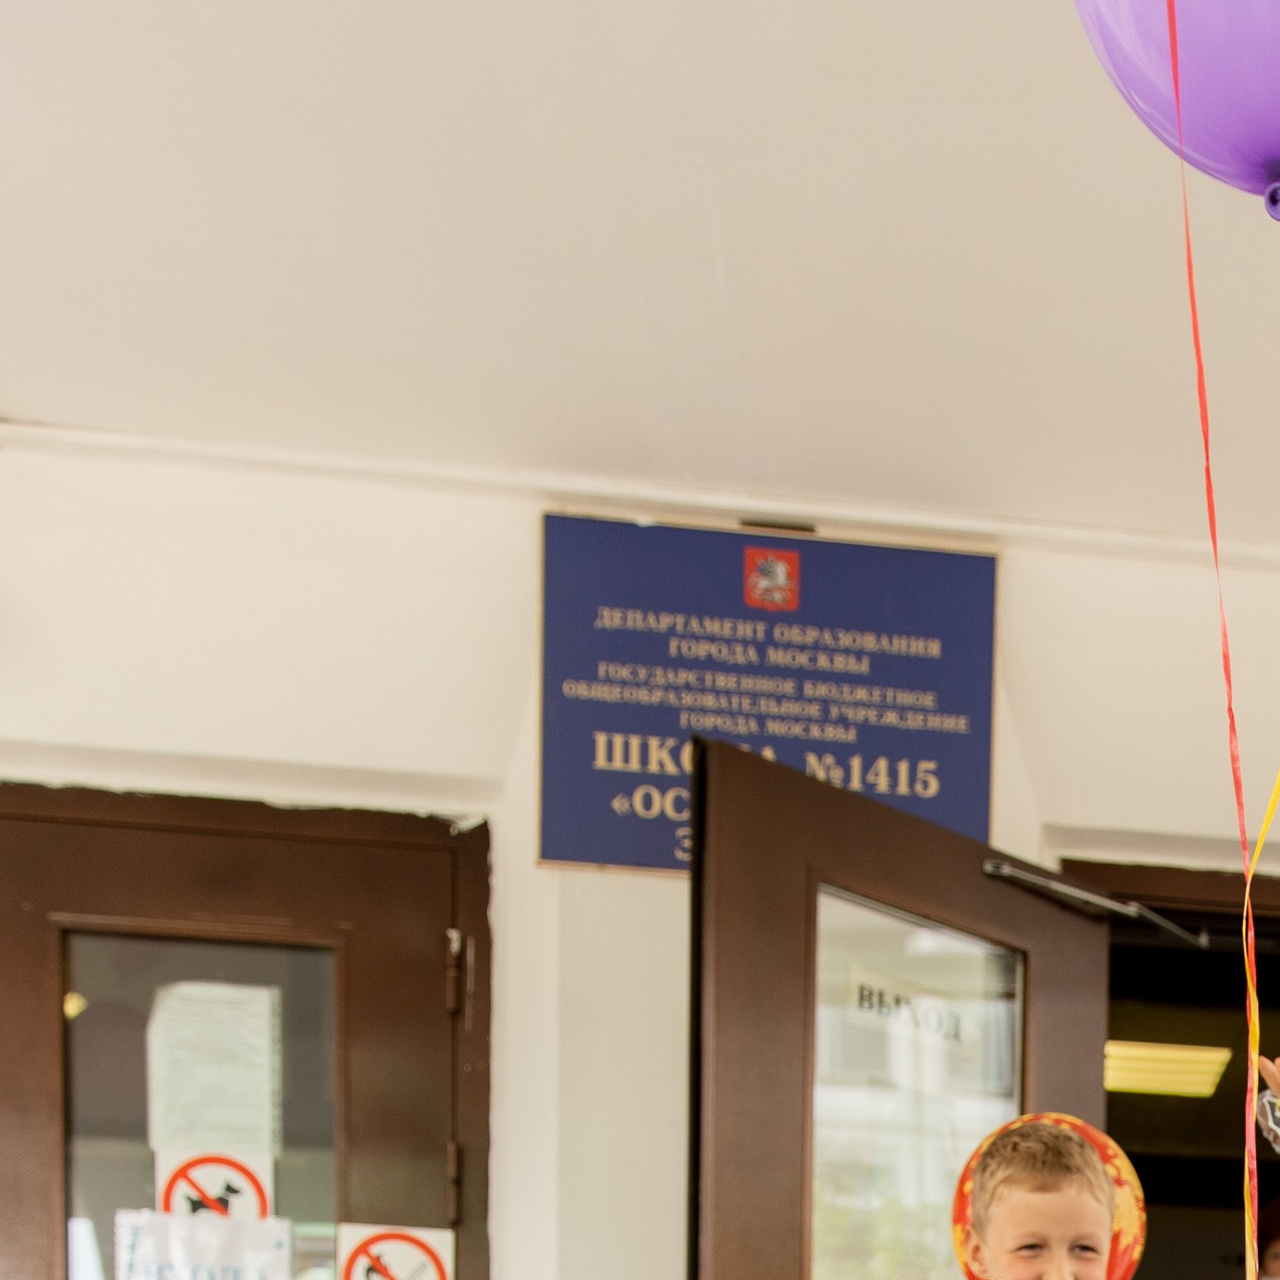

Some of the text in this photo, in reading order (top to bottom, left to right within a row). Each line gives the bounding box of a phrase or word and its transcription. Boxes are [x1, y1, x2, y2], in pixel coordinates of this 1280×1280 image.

[594, 606, 942, 660] ДЕПАРТАМЕНТ ОБРАЗОВАНИЯ
[668, 636, 871, 676] ГОРОДА МОСКВЫ
[562, 678, 971, 735] ОБЩЕОБРАЗОВАТЕЛЬНОЕ УЧРЕЖДЕНИЕ
[597, 661, 938, 711] ГОСУДАРСТВЕННОЕ БЮДЖЕТНОЕ
[680, 709, 858, 744] ГОРОДА МОСКВЫ
